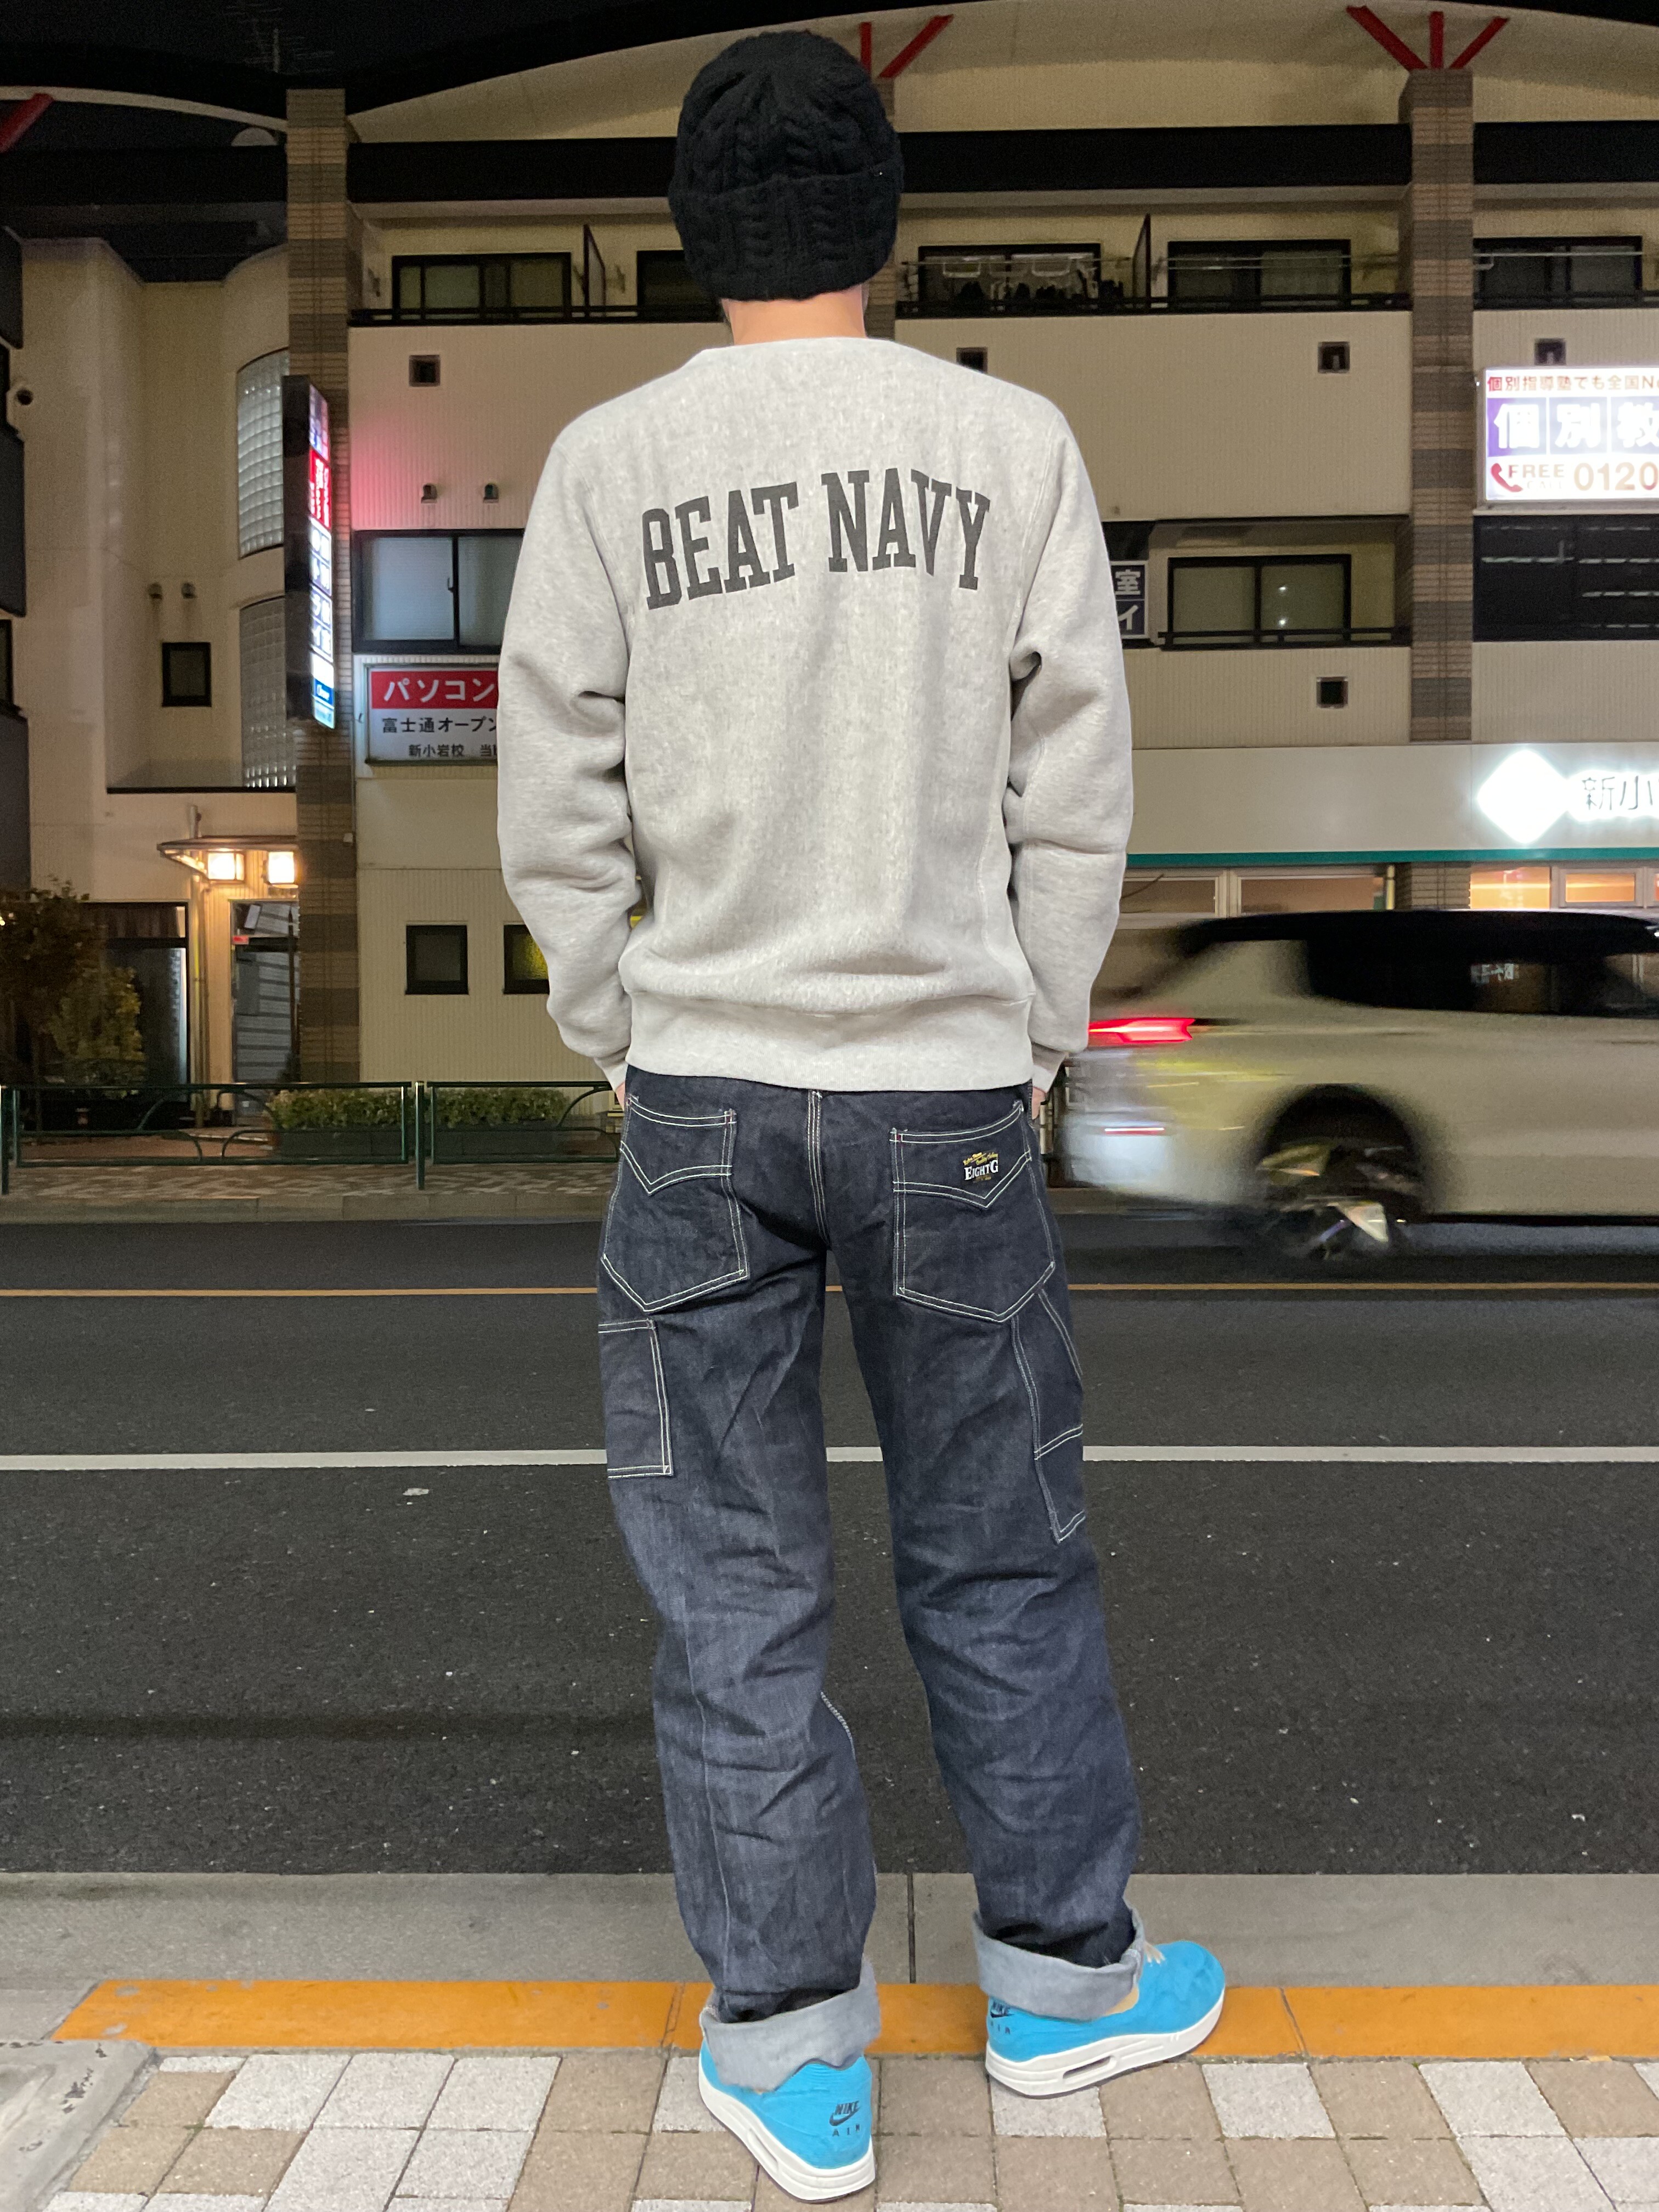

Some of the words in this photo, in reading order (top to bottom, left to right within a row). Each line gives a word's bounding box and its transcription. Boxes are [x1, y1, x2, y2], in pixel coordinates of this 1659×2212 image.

[1508, 464, 1565, 479] FREE
[1573, 461, 1659, 492] 0120
[642, 482, 799, 610] BEAT
[821, 468, 990, 590] NAVY
[384, 678, 495, 703] パソコン
[409, 744, 465, 758] 新小岩校
[834, 2100, 860, 2115] NIKE
[832, 2124, 860, 2137] AIR
